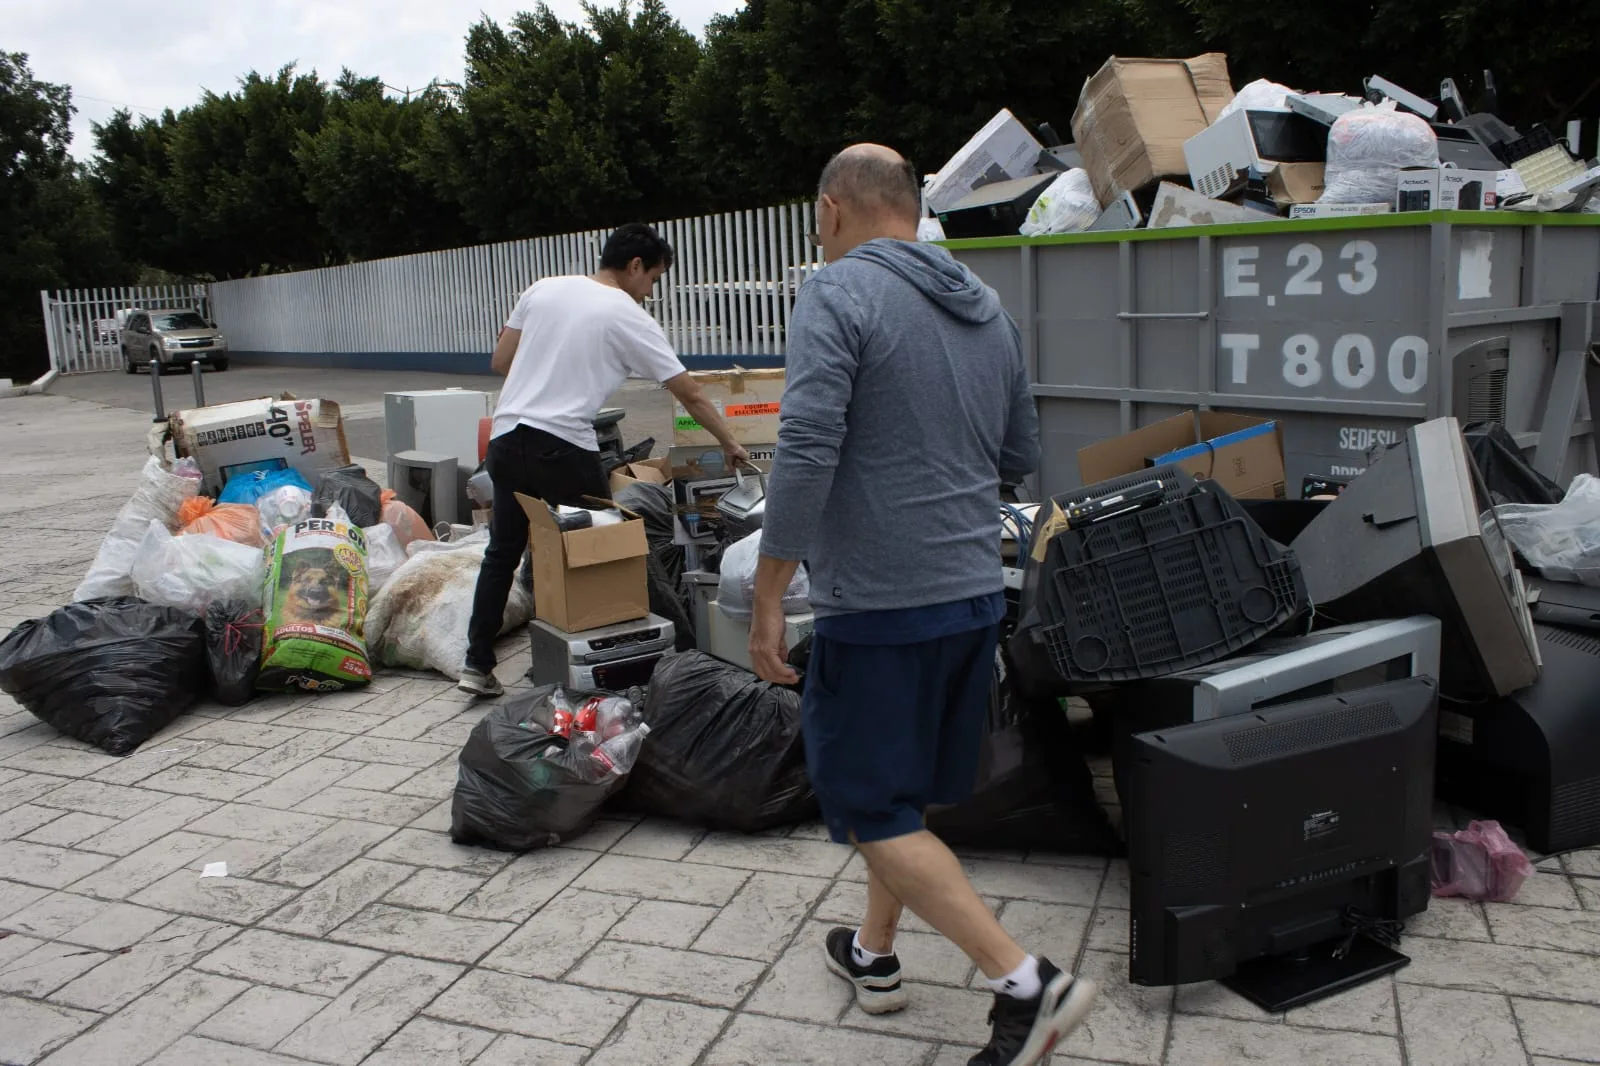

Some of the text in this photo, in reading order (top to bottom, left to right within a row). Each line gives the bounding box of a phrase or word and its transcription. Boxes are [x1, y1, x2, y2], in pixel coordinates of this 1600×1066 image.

[1293, 206, 1317, 214] EPSON
[1281, 333, 1429, 395] 800
[678, 419, 704, 427] APRO
[274, 625, 314, 637] ADULTOS
